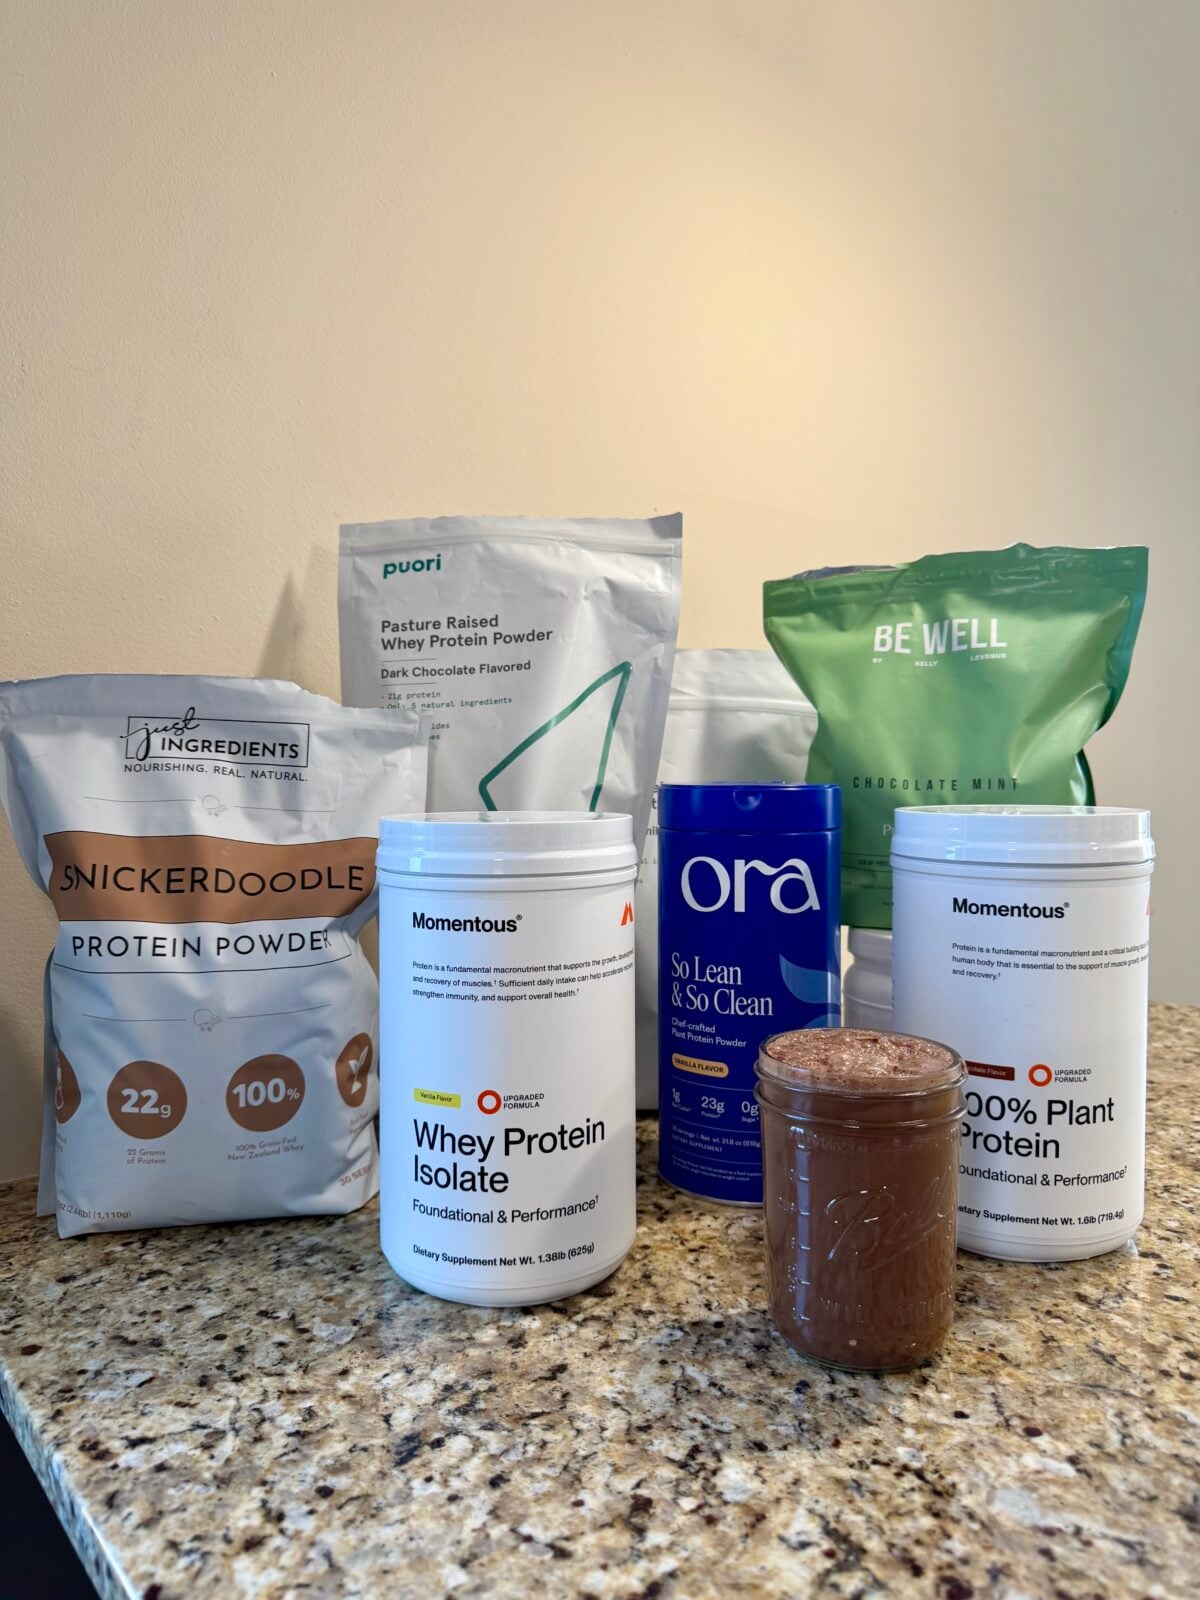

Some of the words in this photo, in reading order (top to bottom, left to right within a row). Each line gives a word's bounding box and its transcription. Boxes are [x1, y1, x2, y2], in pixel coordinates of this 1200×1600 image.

[383, 553, 442, 579] puori
[381, 618, 442, 633] Pasture
[446, 614, 499, 630] Raised
[381, 636, 425, 652] Whey
[430, 632, 488, 649] Protein
[493, 628, 553, 645] Powder
[873, 622, 912, 654] BE
[922, 617, 1008, 655] WELL
[381, 667, 409, 680] Dark
[412, 664, 476, 677] Chocolate
[479, 660, 531, 674] Flavored
[406, 691, 441, 701] protein
[421, 701, 455, 709] natural
[460, 697, 512, 708] ingredients
[120, 707, 200, 761] just
[161, 737, 299, 760] INGREDIENTS
[124, 762, 208, 774] NOURISHING.
[214, 766, 246, 779] REAL.
[251, 770, 308, 782] NATURAL.
[853, 776, 958, 792] CHOCOLATE
[972, 777, 1019, 791] MINT
[60, 863, 365, 897] SNICKERDOODLE
[72, 935, 200, 958] PROTEIN
[216, 929, 332, 957] POWDER
[953, 942, 976, 952] Protein
[992, 947, 1039, 956] fundamental
[1041, 950, 1090, 958] macronutrient
[1092, 949, 1103, 957] and
[412, 961, 433, 971] Protein
[446, 964, 492, 974] fundamental
[493, 964, 546, 974] macronutrient
[548, 963, 562, 972] that
[563, 960, 591, 971] supports
[592, 959, 601, 967] the
[671, 952, 689, 980] So
[694, 956, 743, 986] Lean
[952, 968, 965, 976] and
[953, 955, 975, 964] human
[977, 958, 995, 968] body
[996, 960, 1012, 968] that
[1021, 962, 1055, 970] essential
[1078, 962, 1103, 971] support
[413, 975, 423, 983] and
[424, 977, 452, 987] recovery
[499, 979, 535, 987] Sufficient
[537, 978, 554, 987] daily
[556, 976, 576, 984] intake
[577, 974, 588, 982] can
[590, 972, 601, 980] help
[413, 989, 444, 999] strengthen
[446, 992, 480, 1002] immunity,
[481, 993, 495, 1001] and
[497, 993, 527, 1003] support
[528, 991, 553, 1000] overall
[671, 981, 683, 1008] &
[686, 984, 709, 1013] So
[714, 988, 774, 1017] Clean
[671, 1017, 716, 1034] Chef-crafted
[671, 1028, 686, 1040] Plant
[687, 1031, 714, 1045] Protein
[715, 1036, 747, 1048] Powder
[674, 1058, 697, 1070] VANILLA
[697, 1063, 724, 1074] FLAVOR
[988, 1068, 1006, 1077] Flavor
[1054, 1068, 1092, 1076] UPGRADED
[231, 1077, 300, 1108] 100%
[420, 1091, 436, 1100] Vanilla
[436, 1094, 453, 1103] Flavor
[503, 1093, 545, 1102] UPGRADED
[120, 1088, 171, 1118] 22g
[503, 1102, 540, 1110] FORMULA
[701, 1096, 725, 1114] 23g
[741, 1101, 759, 1116] 0g
[965, 1091, 1037, 1125] 00%
[1047, 1097, 1115, 1126] Plant
[236, 1143, 256, 1152] 100%
[413, 1118, 495, 1163] Whey
[504, 1117, 605, 1157] Protein
[688, 1140, 723, 1153] SUPPLEMENT
[127, 1148, 137, 1156] 22
[139, 1148, 166, 1156] Grams
[137, 1157, 166, 1165] Protein
[248, 1147, 280, 1159] Zealand
[414, 1155, 509, 1193] Isolate
[959, 1164, 1037, 1186] oundational
[1040, 1174, 1050, 1186] &
[413, 1198, 494, 1223] Foundational
[497, 1209, 508, 1223] &
[958, 1205, 981, 1218] etary
[983, 1209, 1040, 1225] Supplement
[1042, 1216, 1059, 1226] Net
[1060, 1216, 1076, 1226] Wt.
[1077, 1213, 1097, 1225] 1.6lb
[1097, 1208, 1125, 1225] (719.4g)
[413, 1244, 440, 1262] Dietary
[442, 1252, 498, 1267] Supplement
[499, 1256, 517, 1266] Net
[519, 1254, 536, 1266] Wt.
[537, 1251, 566, 1264] 1.38lb
[568, 1241, 595, 1261] (625g)
